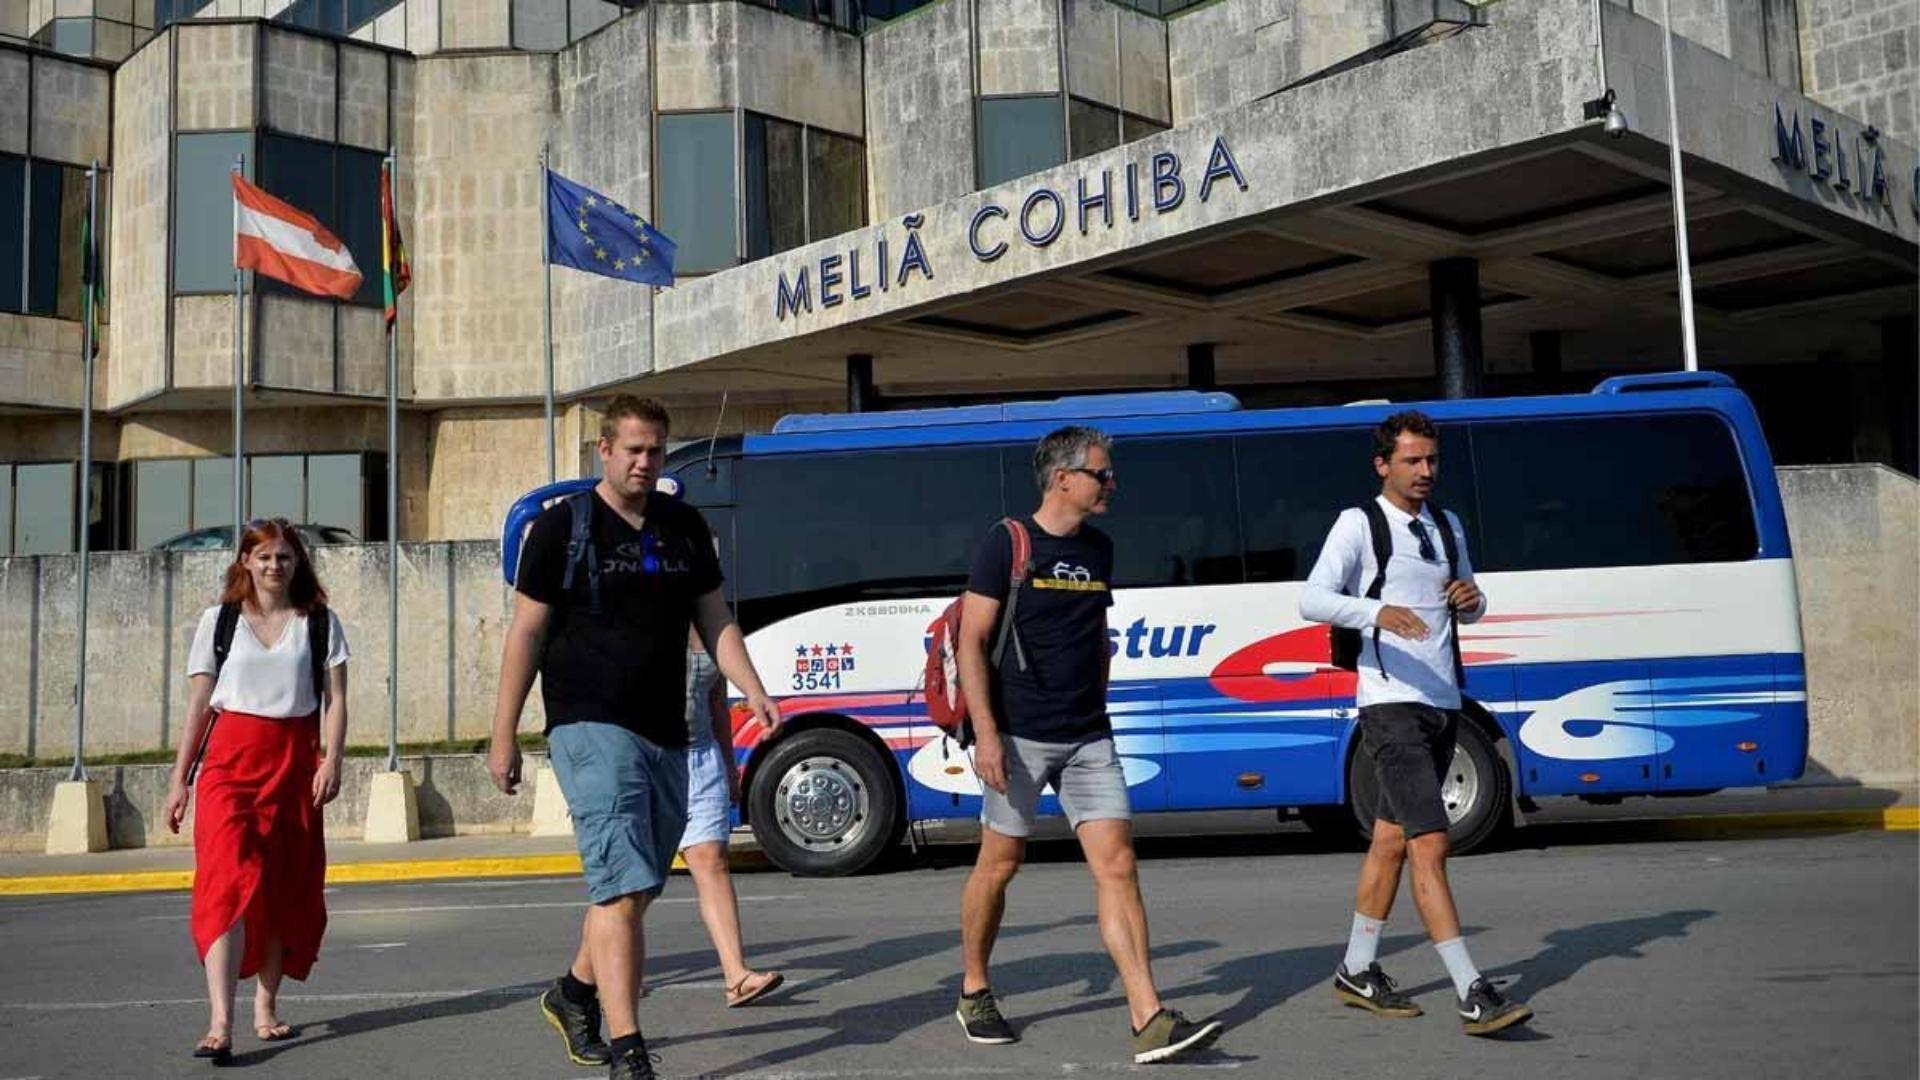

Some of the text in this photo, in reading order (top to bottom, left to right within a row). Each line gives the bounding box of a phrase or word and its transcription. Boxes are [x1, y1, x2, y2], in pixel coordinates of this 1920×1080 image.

[969, 135, 1248, 262] COHIBA
[1103, 615, 1217, 659] stur
[792, 671, 841, 691] 3541
